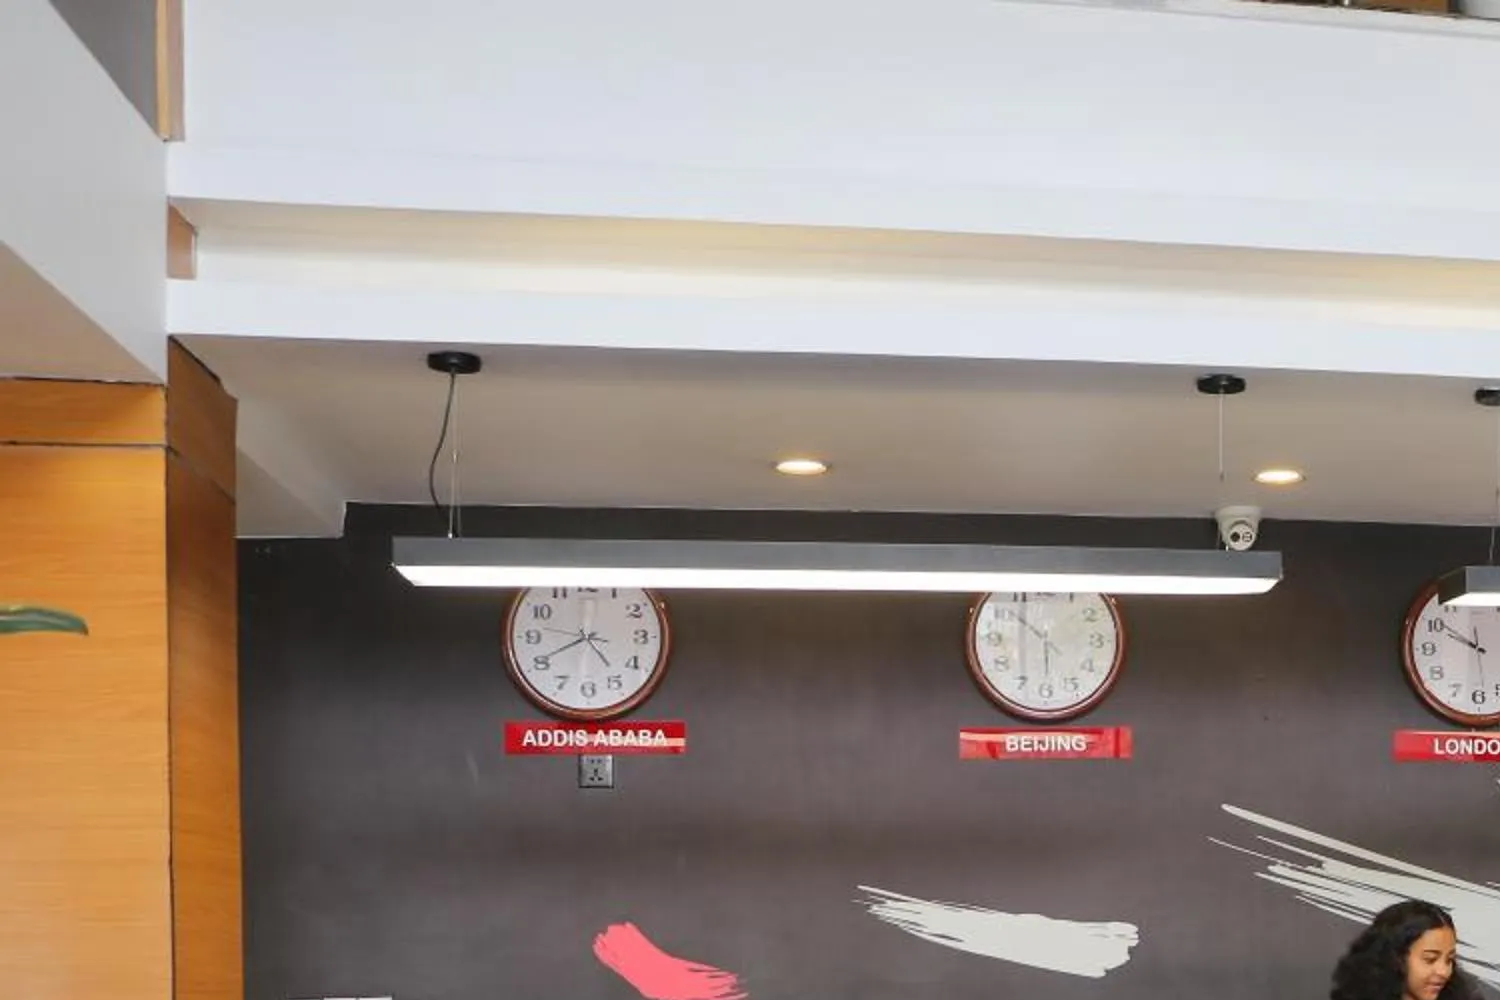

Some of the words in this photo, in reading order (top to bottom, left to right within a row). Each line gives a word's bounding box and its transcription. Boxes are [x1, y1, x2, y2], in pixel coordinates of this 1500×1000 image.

[532, 604, 551, 619] 10
[626, 604, 642, 618] 2
[1082, 607, 1096, 622] 2
[1427, 618, 1444, 633] 10
[525, 629, 541, 645] 9
[634, 629, 648, 645] 3
[987, 630, 1002, 647] 9
[1089, 633, 1104, 649] 3
[1421, 642, 1436, 656] 9
[533, 655, 550, 671] 8
[625, 656, 639, 670] 4
[1430, 666, 1444, 680] 8
[554, 675, 570, 690] 7
[580, 681, 596, 698] 6
[607, 674, 622, 690] 5
[1014, 675, 1028, 690] 7
[1064, 677, 1080, 692] 5
[1039, 682, 1053, 699] 6
[1449, 684, 1462, 697] 7
[1472, 690, 1485, 705] 6
[522, 730, 589, 747] ADDIS
[594, 730, 668, 747] ABABA
[1005, 735, 1088, 752] BEIJING
